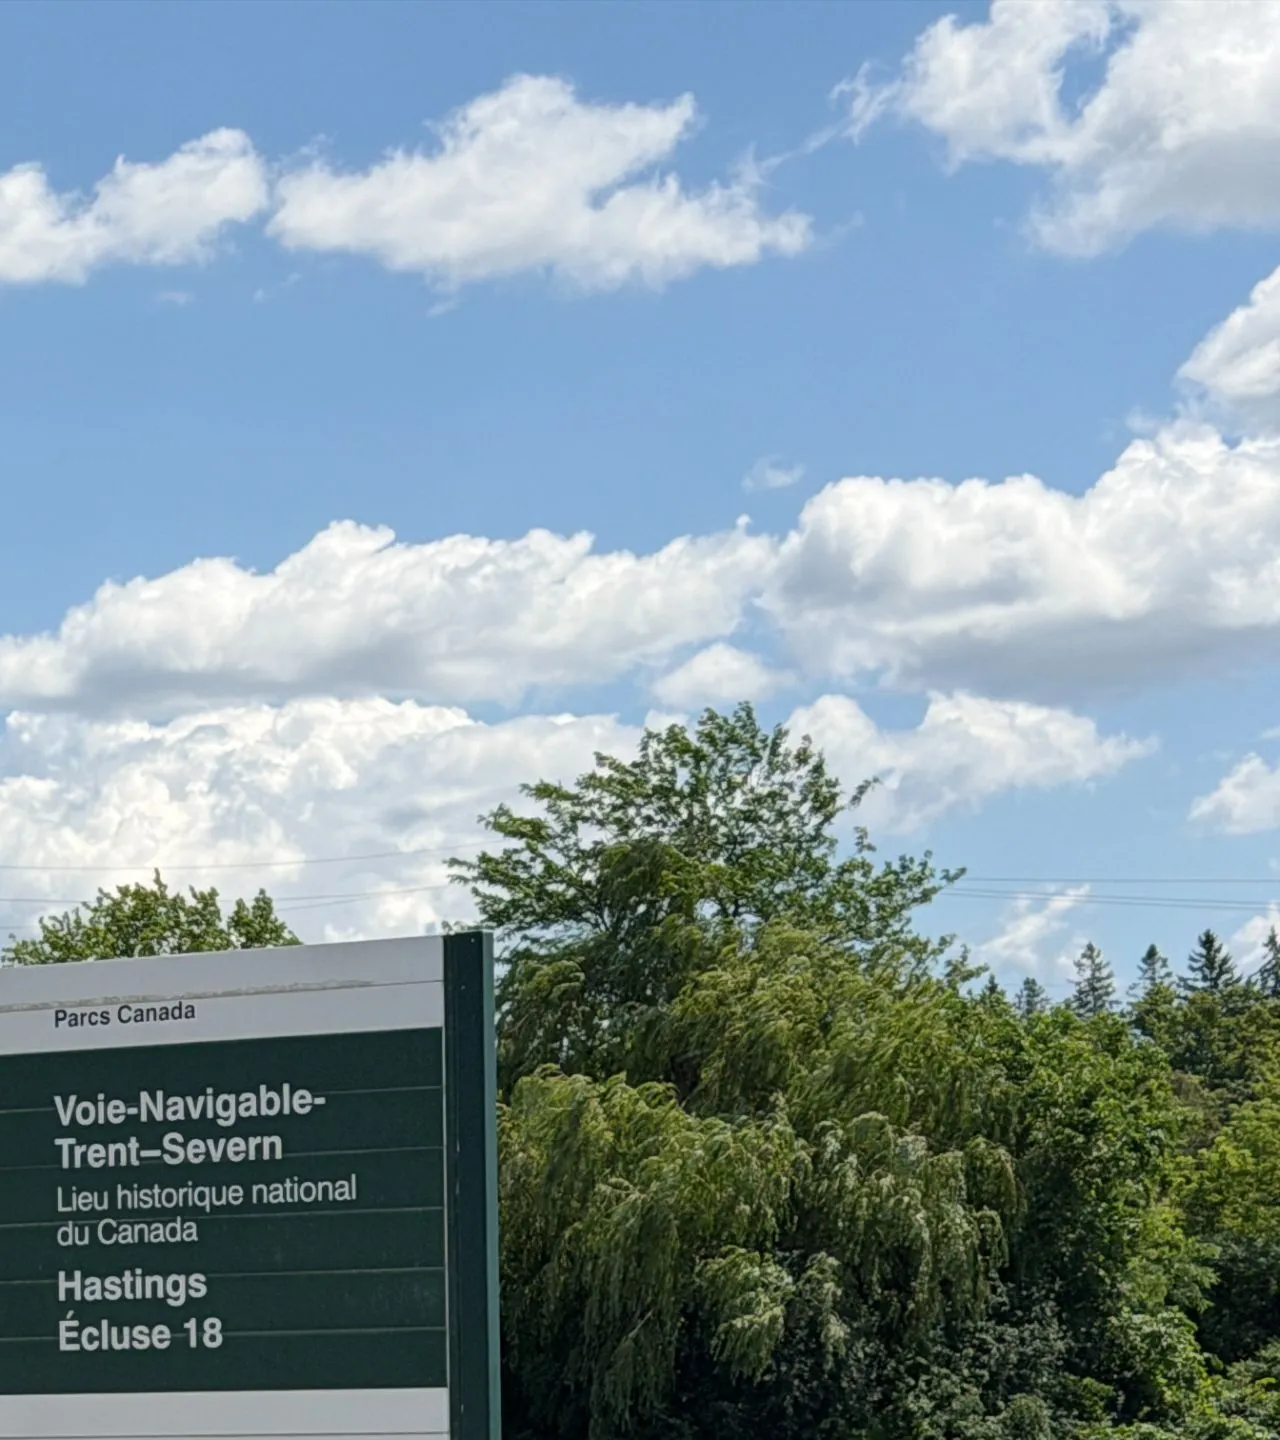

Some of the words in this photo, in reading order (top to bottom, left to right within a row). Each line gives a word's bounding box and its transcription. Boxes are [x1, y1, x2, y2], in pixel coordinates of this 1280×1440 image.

[54, 1009, 110, 1028] Parcs
[117, 1001, 196, 1024] Canada
[54, 1083, 326, 1127] Voie-Navigable-
[57, 1186, 108, 1212] Lieu
[117, 1181, 244, 1213] historique
[252, 1174, 357, 1204] national
[57, 1221, 89, 1246] du
[97, 1216, 198, 1245] Canada
[58, 1268, 207, 1307] Hastings
[59, 1310, 171, 1351] Écluse
[183, 1317, 223, 1348] 18
